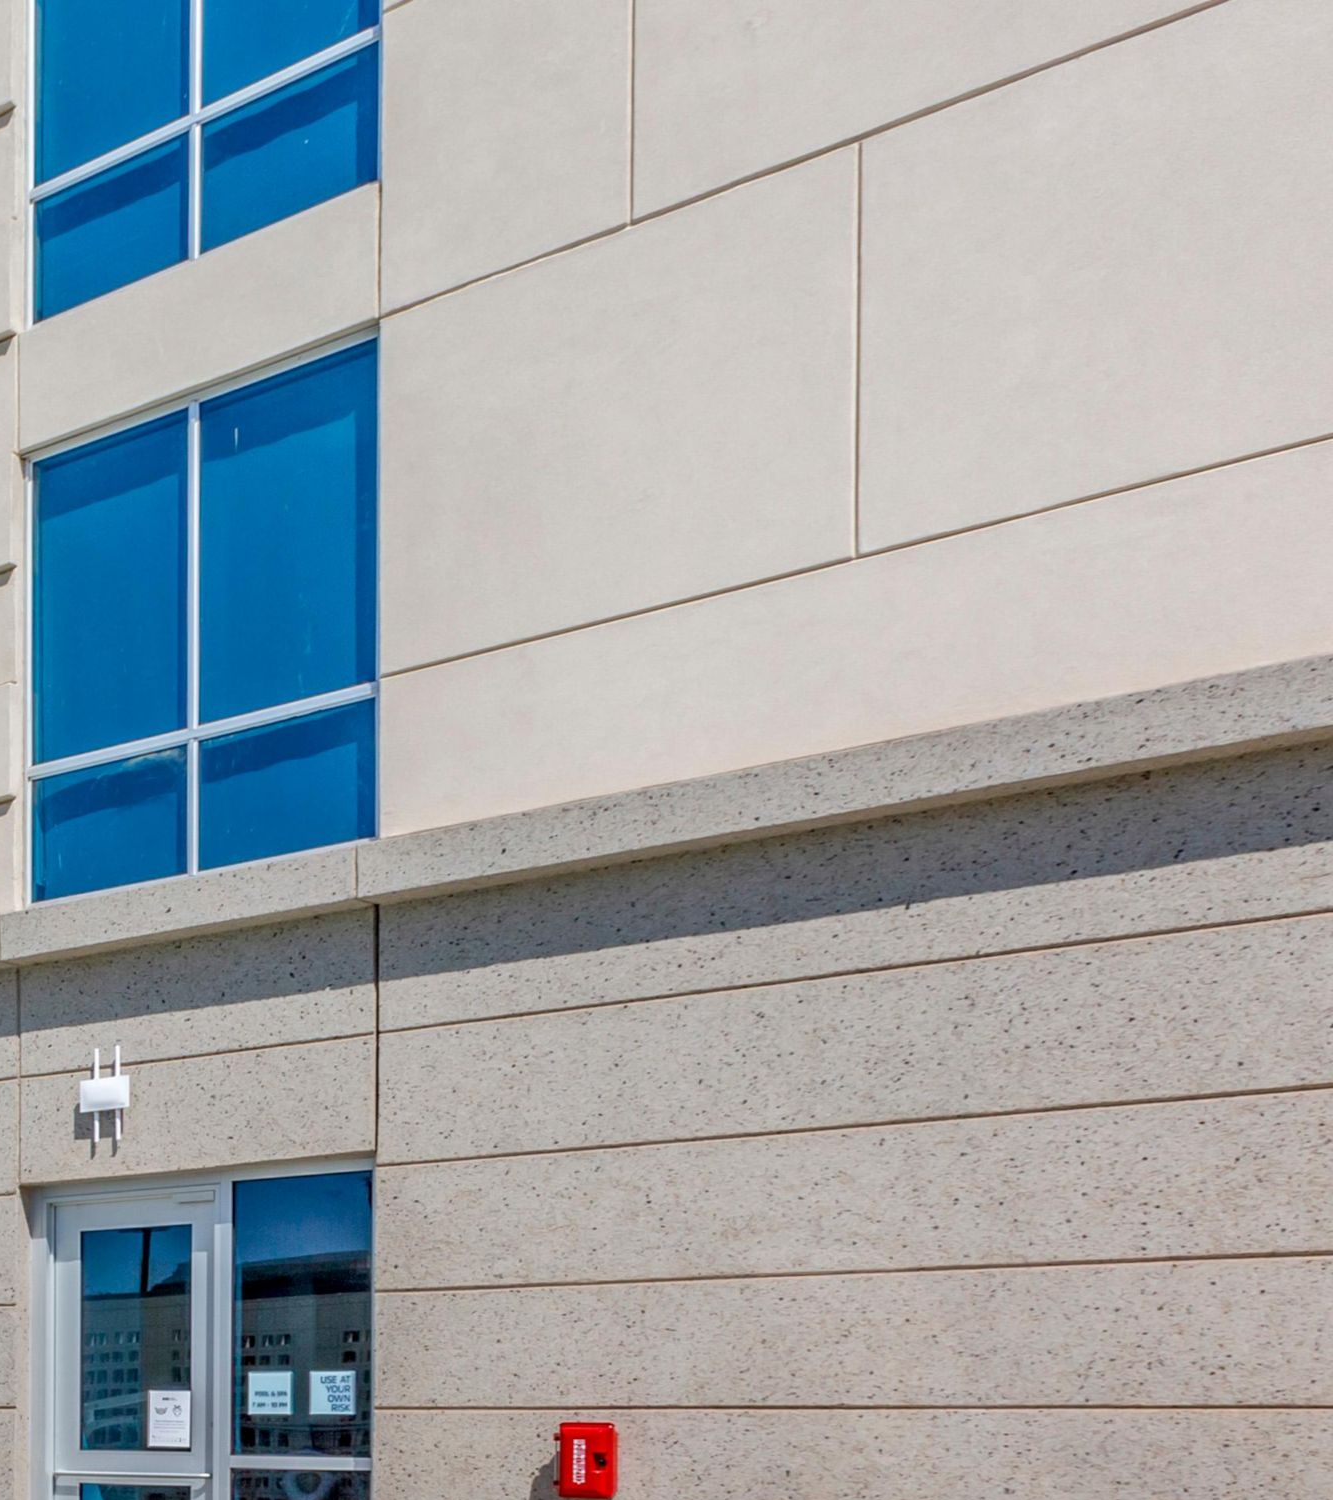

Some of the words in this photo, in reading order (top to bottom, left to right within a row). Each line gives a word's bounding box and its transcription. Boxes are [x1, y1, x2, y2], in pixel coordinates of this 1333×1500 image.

[320, 1376, 337, 1384] USE
[340, 1375, 351, 1383] AT
[325, 1385, 351, 1393] YOUR
[327, 1395, 351, 1403] OWN
[331, 1404, 351, 1412] RISK
